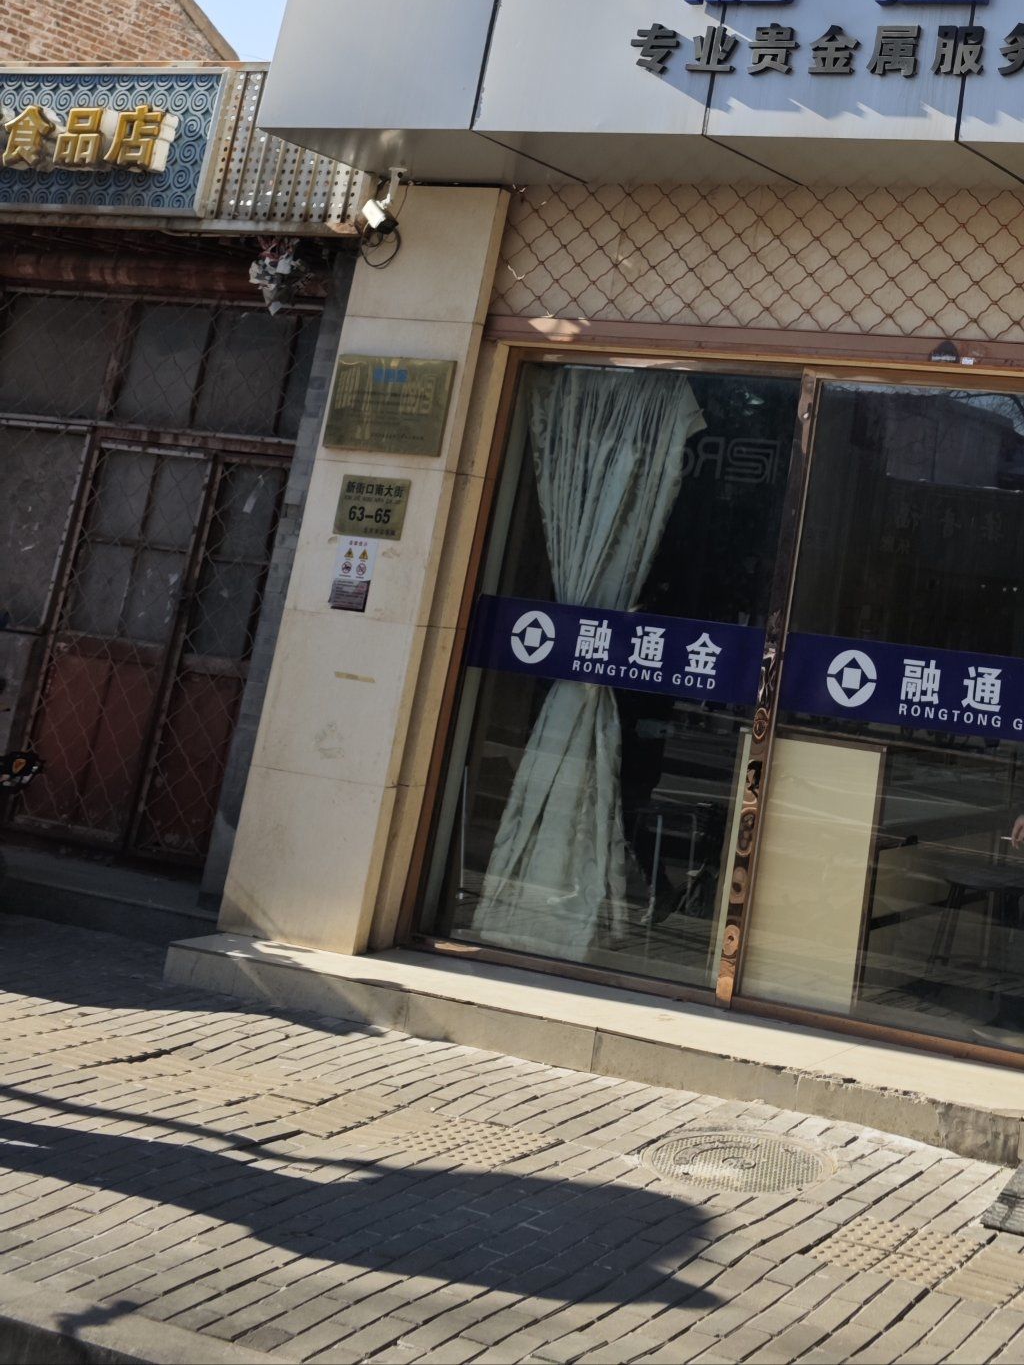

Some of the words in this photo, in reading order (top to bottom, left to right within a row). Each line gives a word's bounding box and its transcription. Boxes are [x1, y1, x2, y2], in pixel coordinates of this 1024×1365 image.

[3, 103, 164, 170] 食品店
[349, 505, 392, 524] 63-65
[573, 617, 723, 677] 融通金
[571, 659, 663, 684] RONGTONG
[671, 673, 717, 691] GOLD
[897, 703, 1003, 729] RONGTONG
